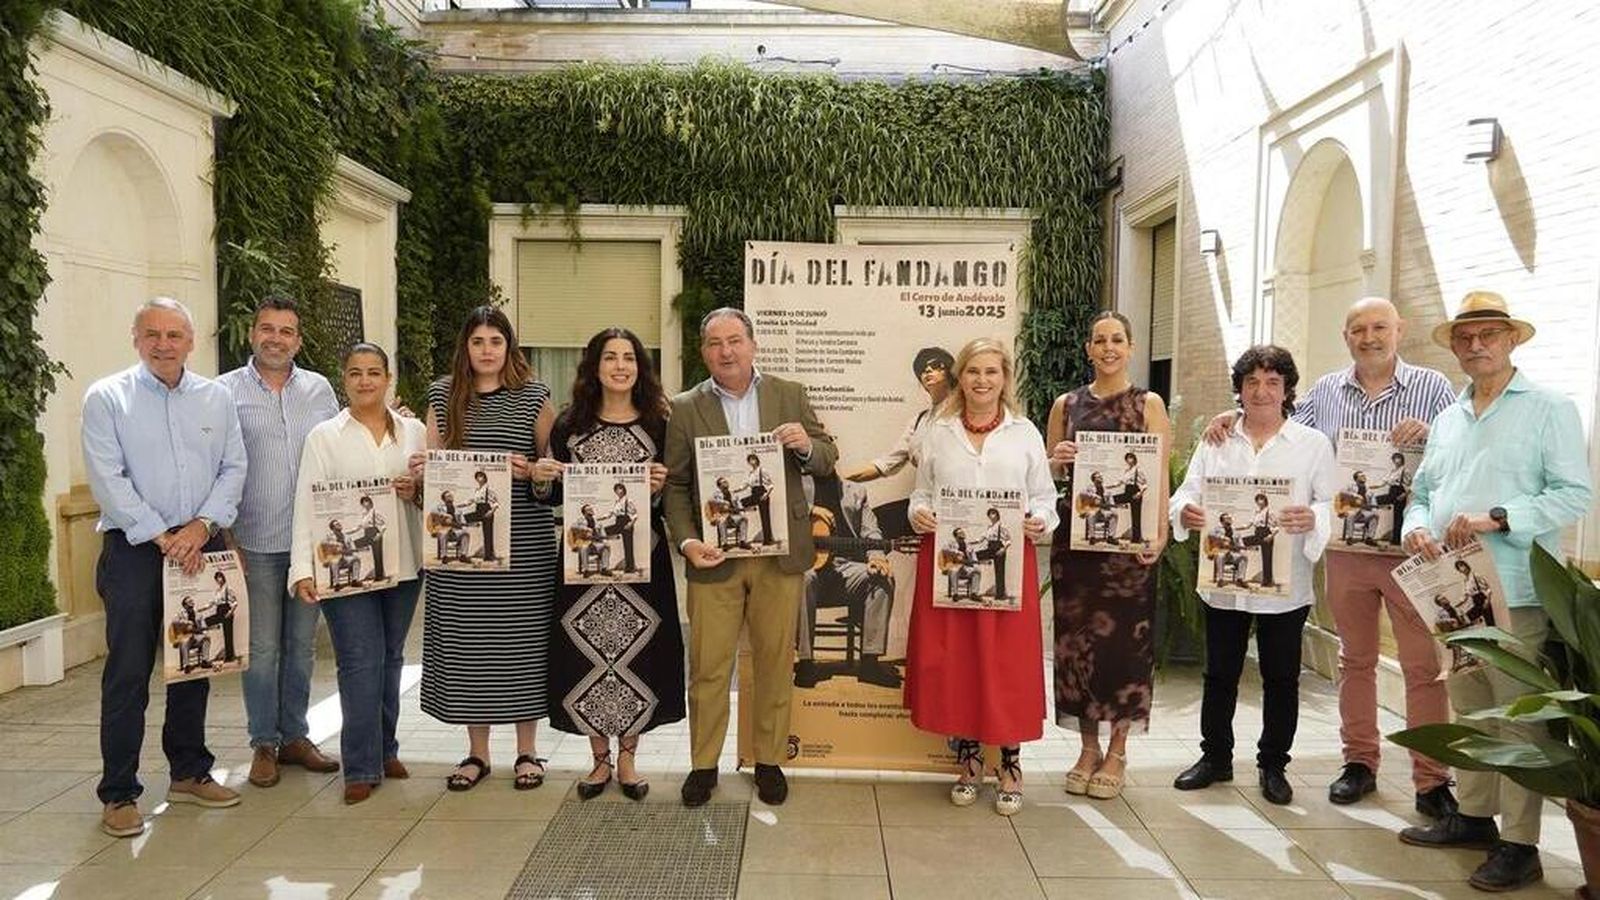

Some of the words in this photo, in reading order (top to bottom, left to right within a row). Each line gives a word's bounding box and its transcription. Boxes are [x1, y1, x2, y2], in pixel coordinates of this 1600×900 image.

[751, 252, 795, 285] DÍA
[807, 259, 852, 286] DEL
[864, 259, 1008, 288] FANDANGO
[900, 292, 910, 301] El
[912, 292, 940, 302] Cerro
[941, 292, 954, 302] de
[956, 292, 1006, 303] Andévalo
[918, 304, 935, 318] 13
